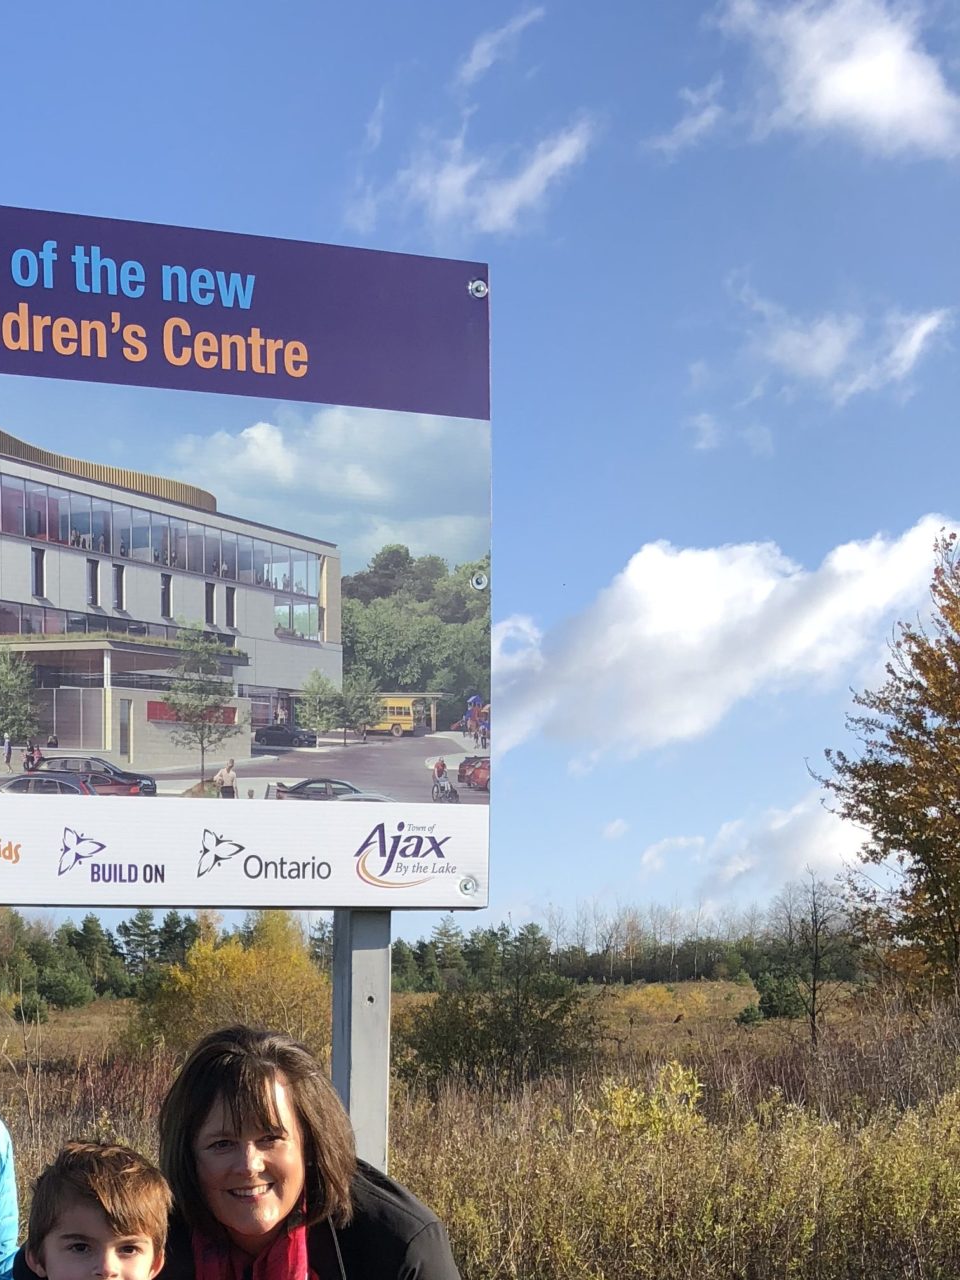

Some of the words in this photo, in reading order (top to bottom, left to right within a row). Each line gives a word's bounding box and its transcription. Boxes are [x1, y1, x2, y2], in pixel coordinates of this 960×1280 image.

[11, 240, 58, 289] of
[71, 245, 146, 298] the
[161, 263, 256, 310] new
[162, 316, 309, 379] Centre
[407, 823, 426, 832] Town
[427, 823, 436, 834] of
[353, 821, 452, 877] Ajax
[90, 863, 138, 883] BUILD
[143, 864, 165, 883] ON
[243, 854, 332, 880] Ontario
[395, 862, 408, 875] By
[412, 862, 428, 874] the
[431, 862, 457, 874] Lake
